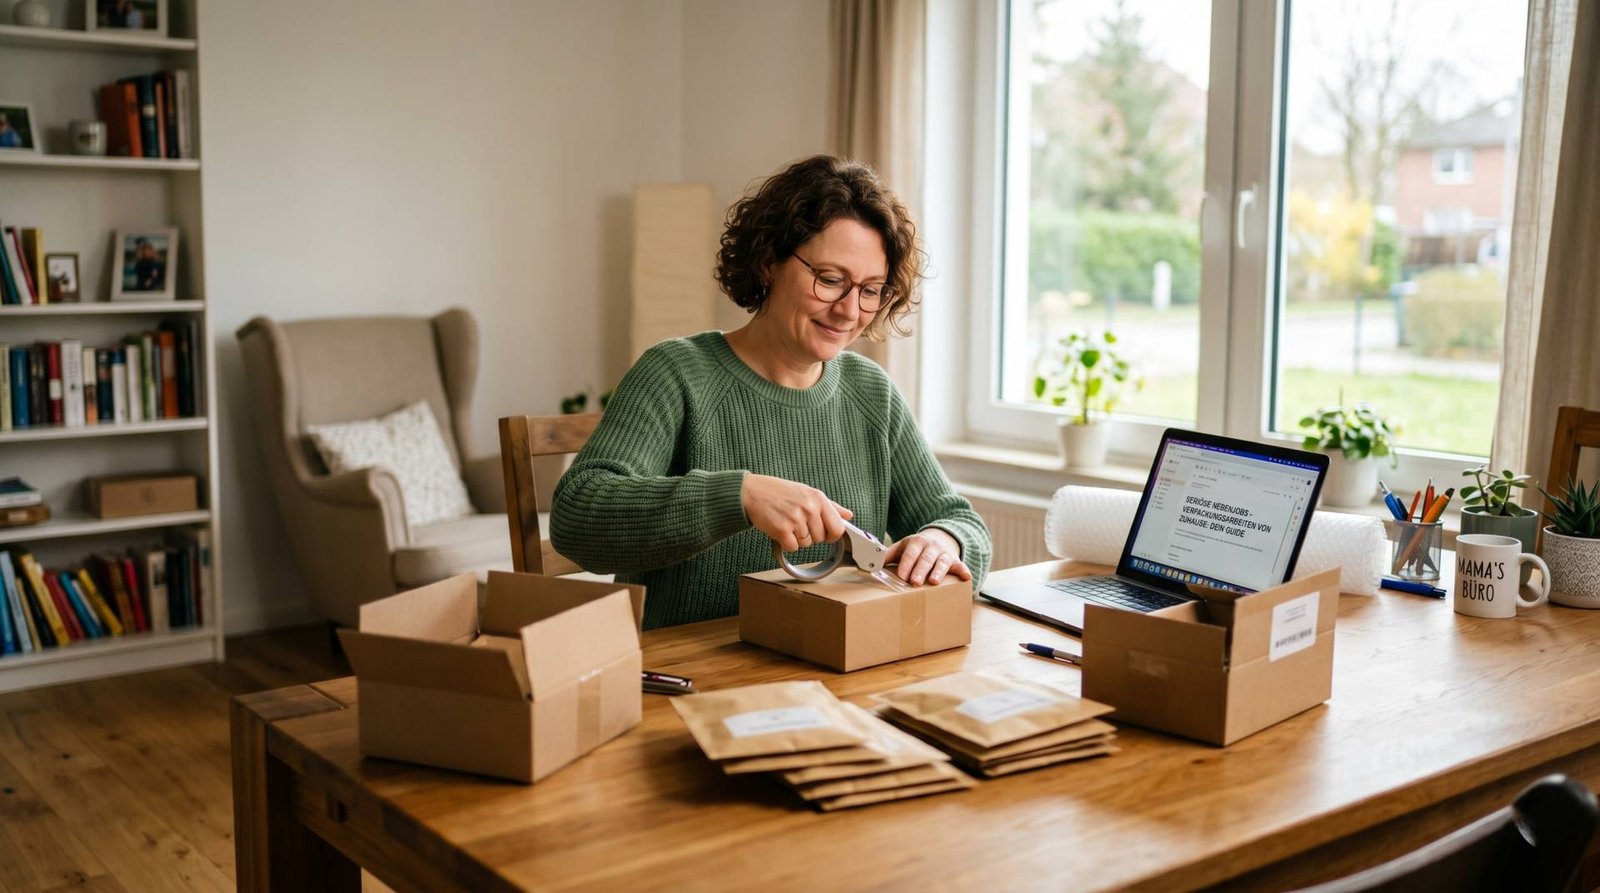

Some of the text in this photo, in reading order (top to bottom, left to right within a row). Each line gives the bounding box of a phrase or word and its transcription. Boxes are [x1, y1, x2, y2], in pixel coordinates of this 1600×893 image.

[1186, 495, 1211, 508] SERIÖSE
[1212, 502, 1249, 517] NEBENJOBS
[1178, 514, 1246, 538] ZUHAUSE: DEIN GUIDE
[1182, 505, 1272, 533] VERPACKUNGSARBEITEN VON
[1458, 556, 1504, 580] MAMA'S
[1462, 579, 1495, 602] BÜRO
